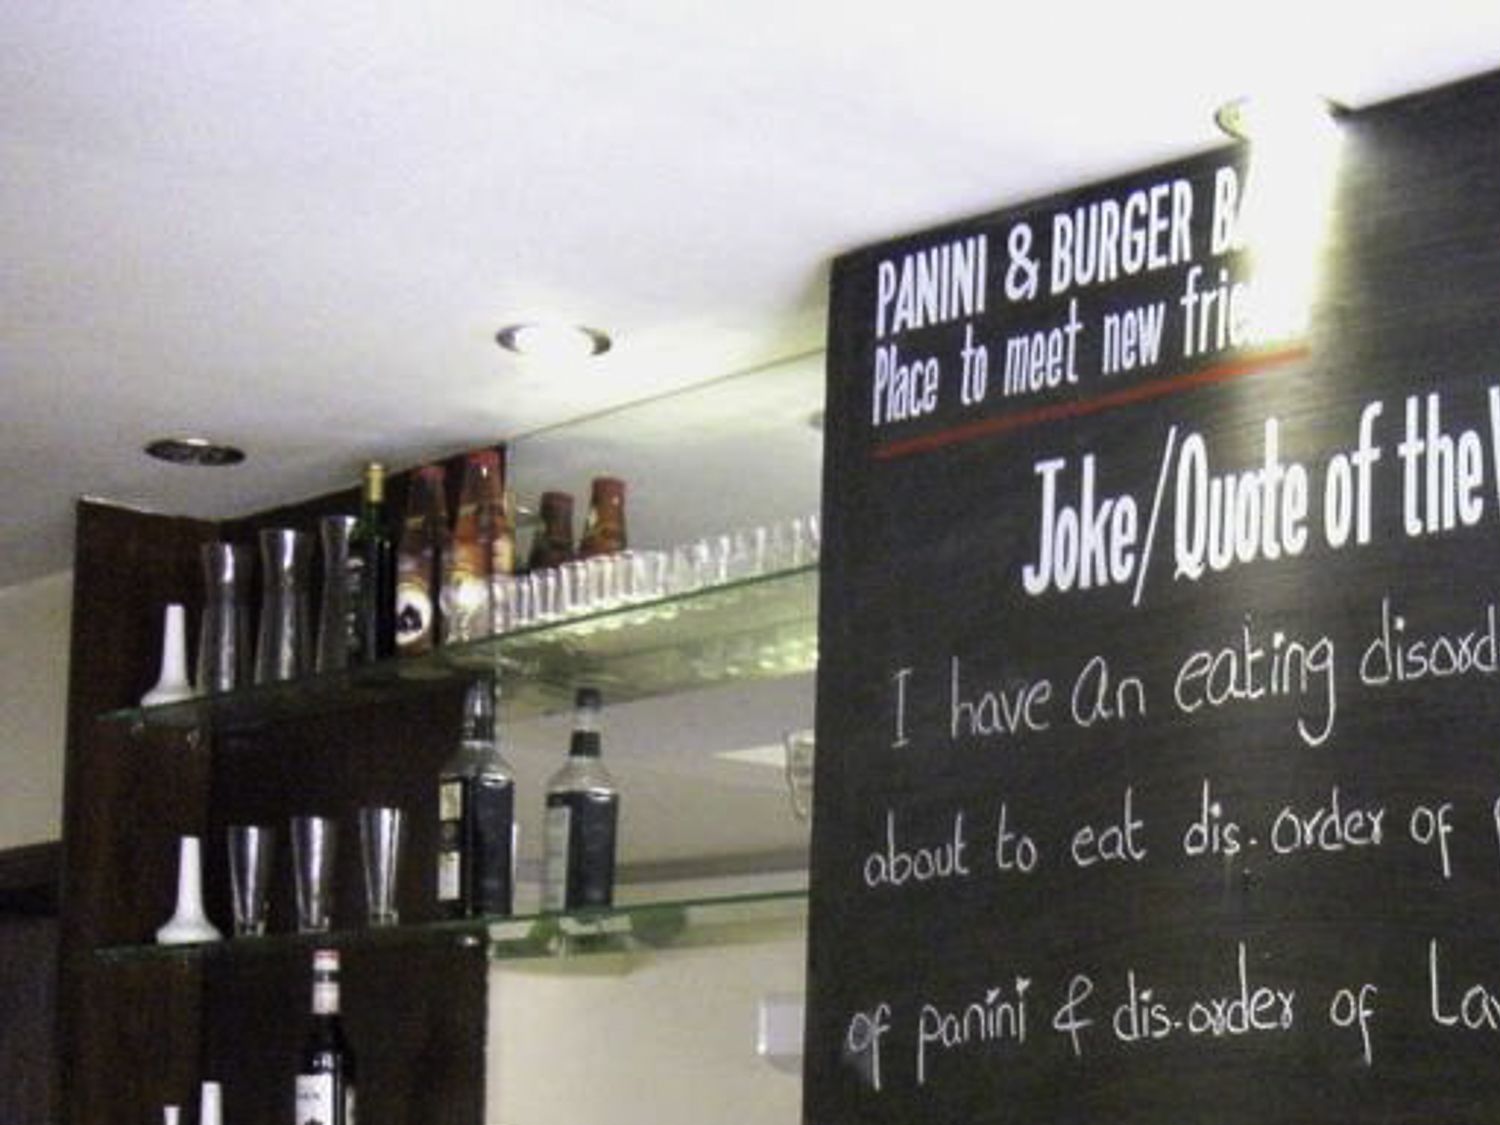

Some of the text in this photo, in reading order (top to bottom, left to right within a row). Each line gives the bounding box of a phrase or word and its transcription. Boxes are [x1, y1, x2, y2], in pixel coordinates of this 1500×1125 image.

[876, 234, 988, 337] PANINI
[1005, 223, 1040, 300] &
[1051, 179, 1193, 295] BURGER
[873, 345, 940, 425] Place
[961, 324, 989, 406] to
[1004, 299, 1082, 396] meet
[1102, 303, 1166, 376] new
[1324, 401, 1383, 547] of
[890, 668, 913, 748] I
[951, 655, 1052, 740] have
[1174, 618, 1335, 747] eating
[863, 808, 970, 888] about
[996, 802, 1037, 872] to
[1071, 785, 1148, 867] eat
[1410, 802, 1454, 880] of
[845, 1002, 891, 1093] of
[917, 975, 1033, 1087] panini
[1329, 984, 1377, 1067] of
